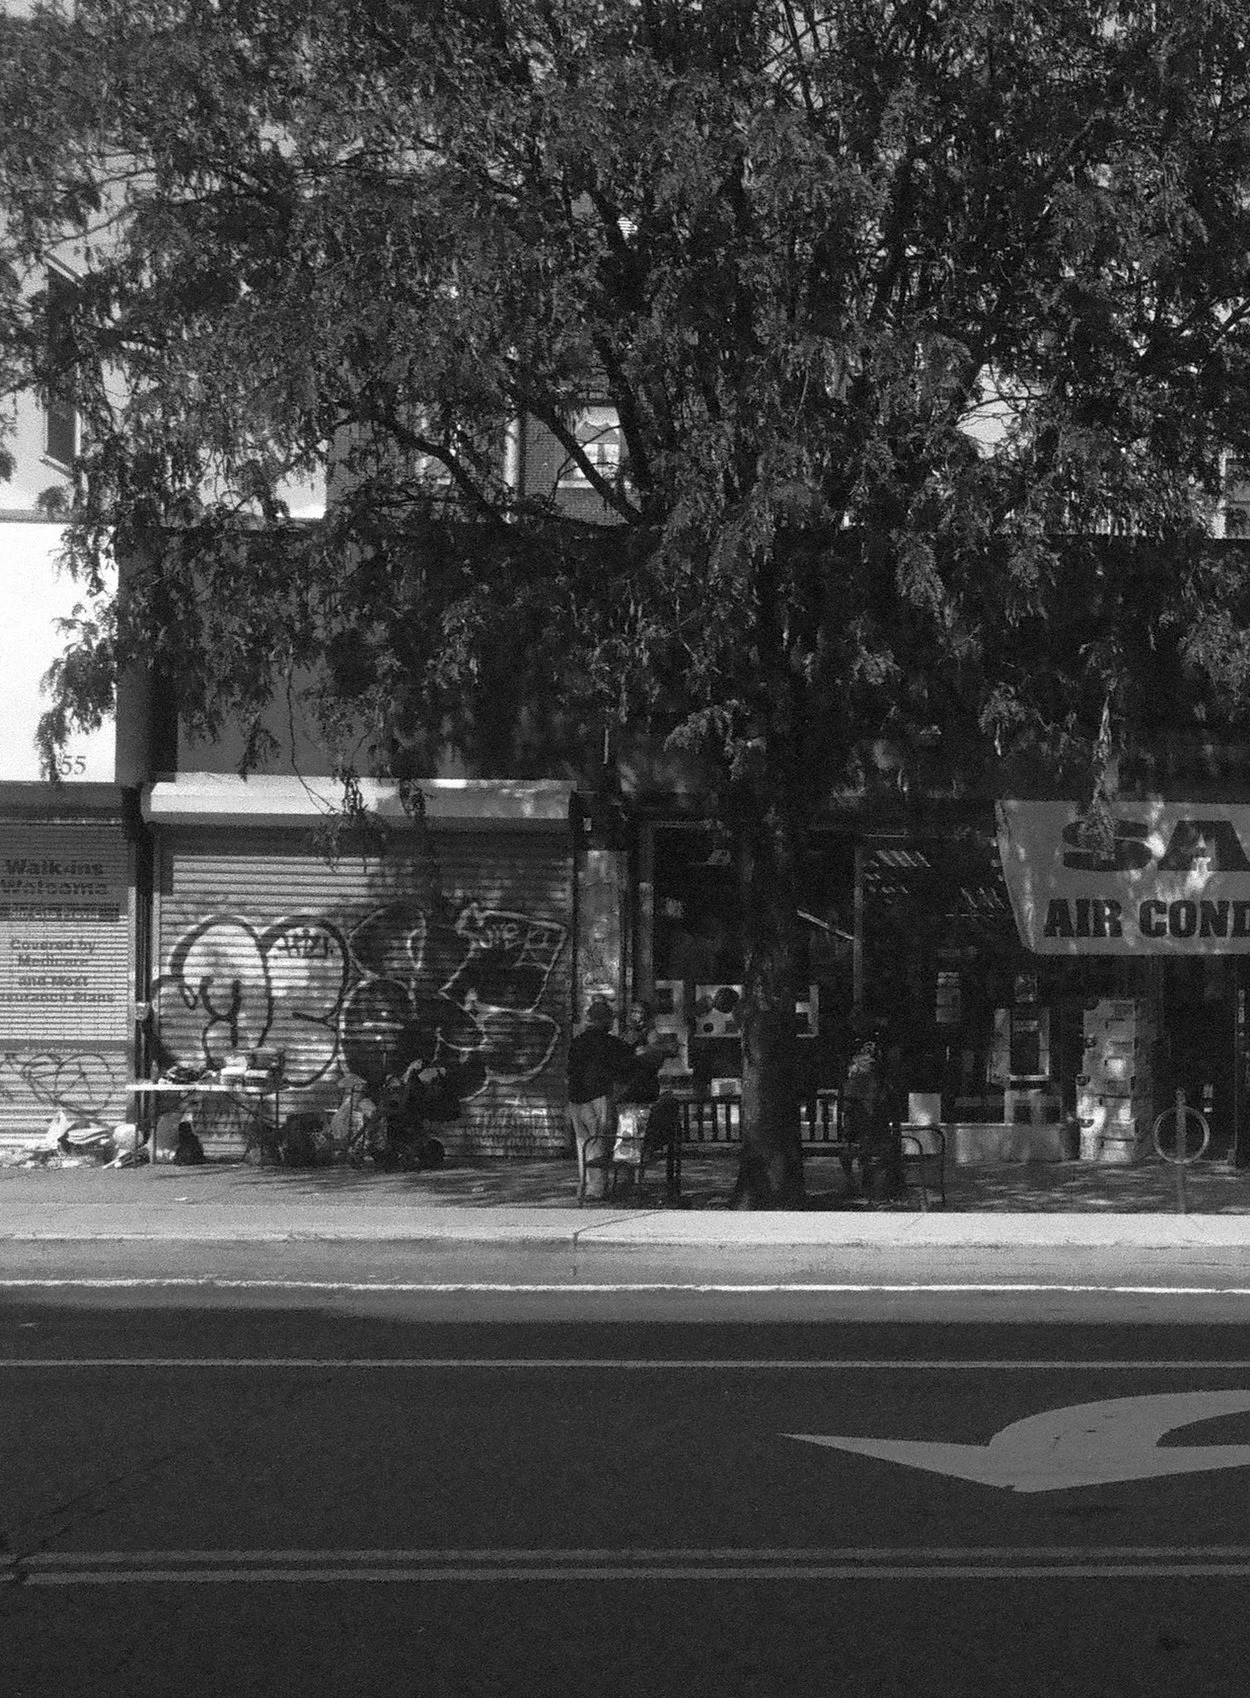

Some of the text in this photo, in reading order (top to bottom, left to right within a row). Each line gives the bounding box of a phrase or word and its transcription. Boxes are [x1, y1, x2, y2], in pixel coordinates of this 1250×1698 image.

[5, 859, 104, 875] Walk-ins
[0, 879, 108, 895] Welcome
[1045, 899, 1122, 938] AIR
